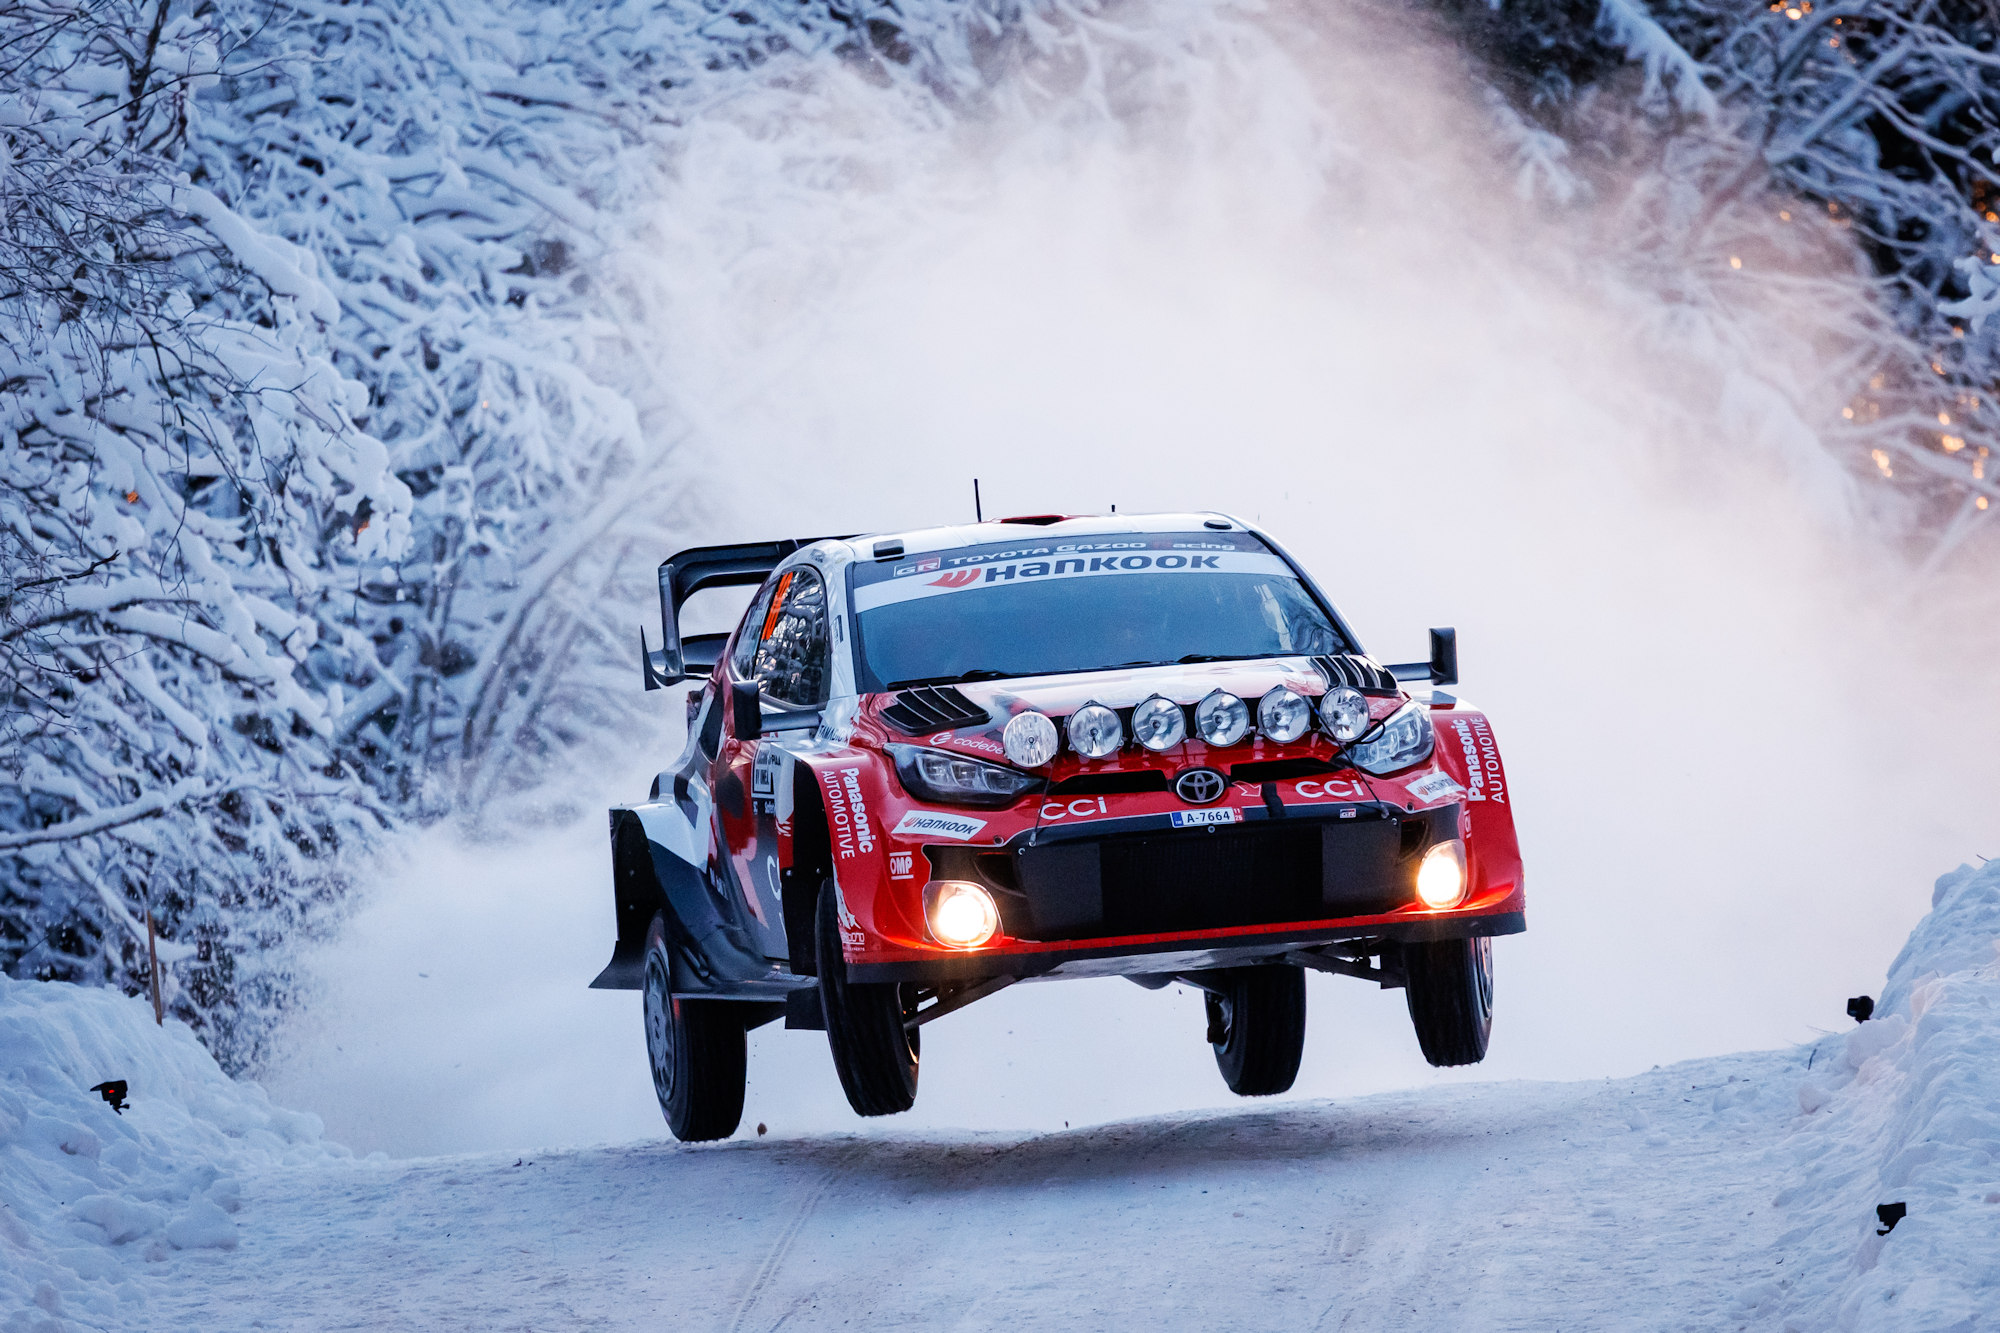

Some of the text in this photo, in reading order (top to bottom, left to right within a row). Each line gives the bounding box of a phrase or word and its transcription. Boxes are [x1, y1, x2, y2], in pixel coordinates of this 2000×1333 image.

[896, 561, 938, 574] GR
[949, 548, 1049, 565] TOYOTA
[1056, 542, 1147, 552] GAZOO
[1451, 719, 1486, 801] Panasonic
[1470, 718, 1505, 804] AUTOMOTIVE
[821, 771, 855, 859] AUTOMOTIVE
[841, 768, 876, 853] Panasonic
[1187, 811, 1230, 823] A-7664
[890, 857, 913, 874] OMP
